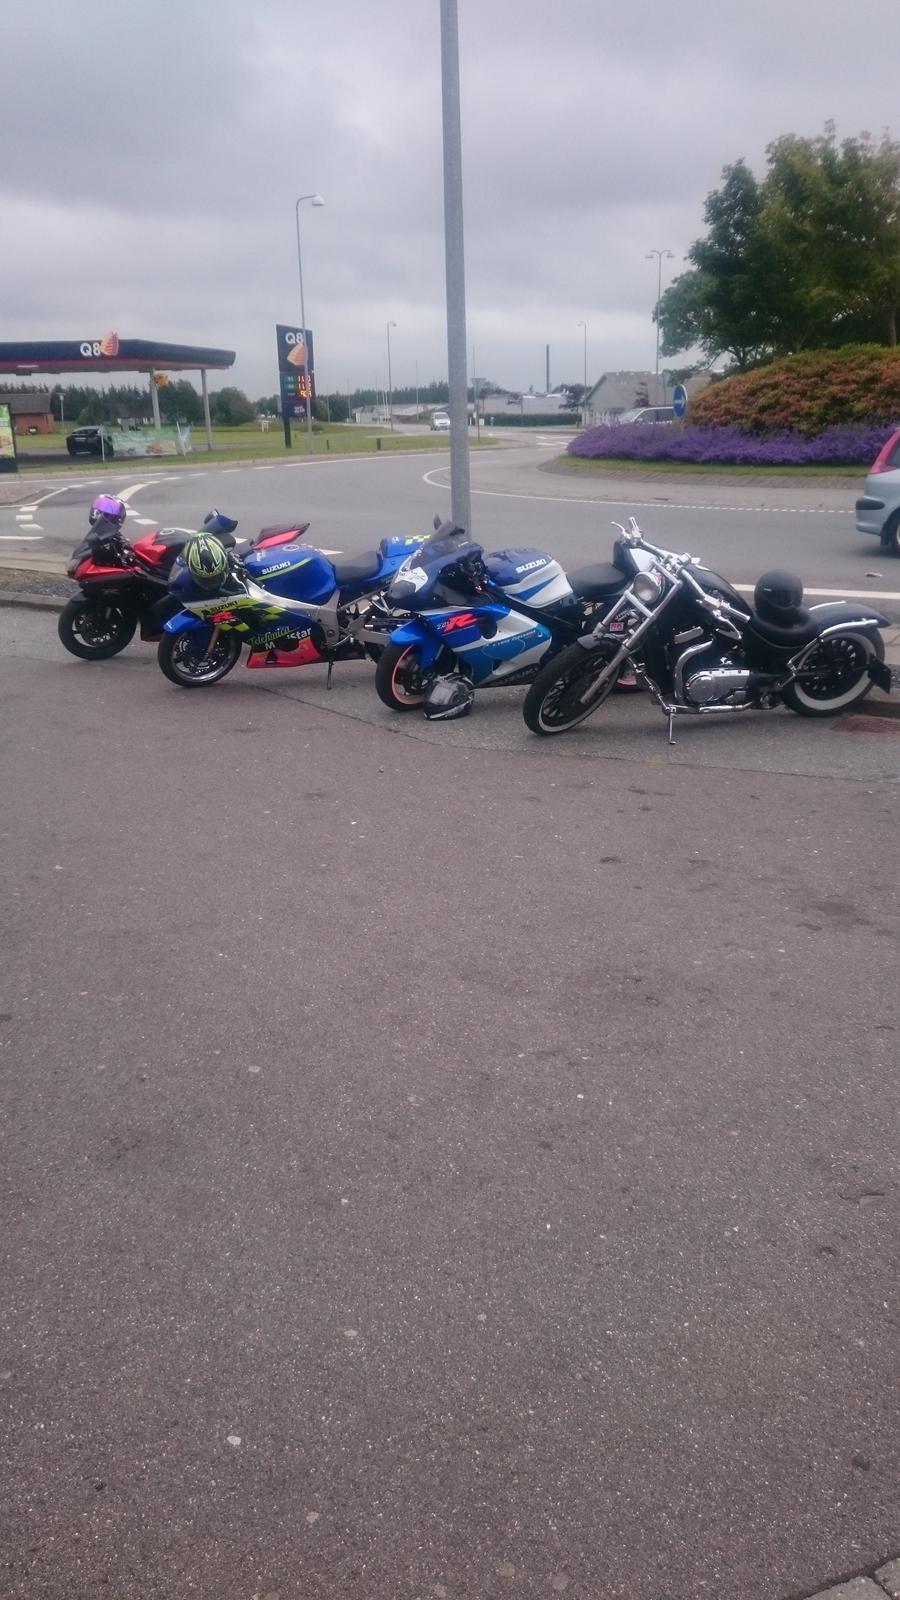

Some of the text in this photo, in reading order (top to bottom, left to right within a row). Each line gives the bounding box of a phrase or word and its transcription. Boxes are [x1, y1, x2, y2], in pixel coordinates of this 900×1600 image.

[285, 332, 304, 344] Q8
[80, 342, 101, 357] Q8
[261, 560, 291, 575] SUZUKI
[515, 558, 547, 574] SUZUKI
[209, 600, 238, 612] SUZUKI
